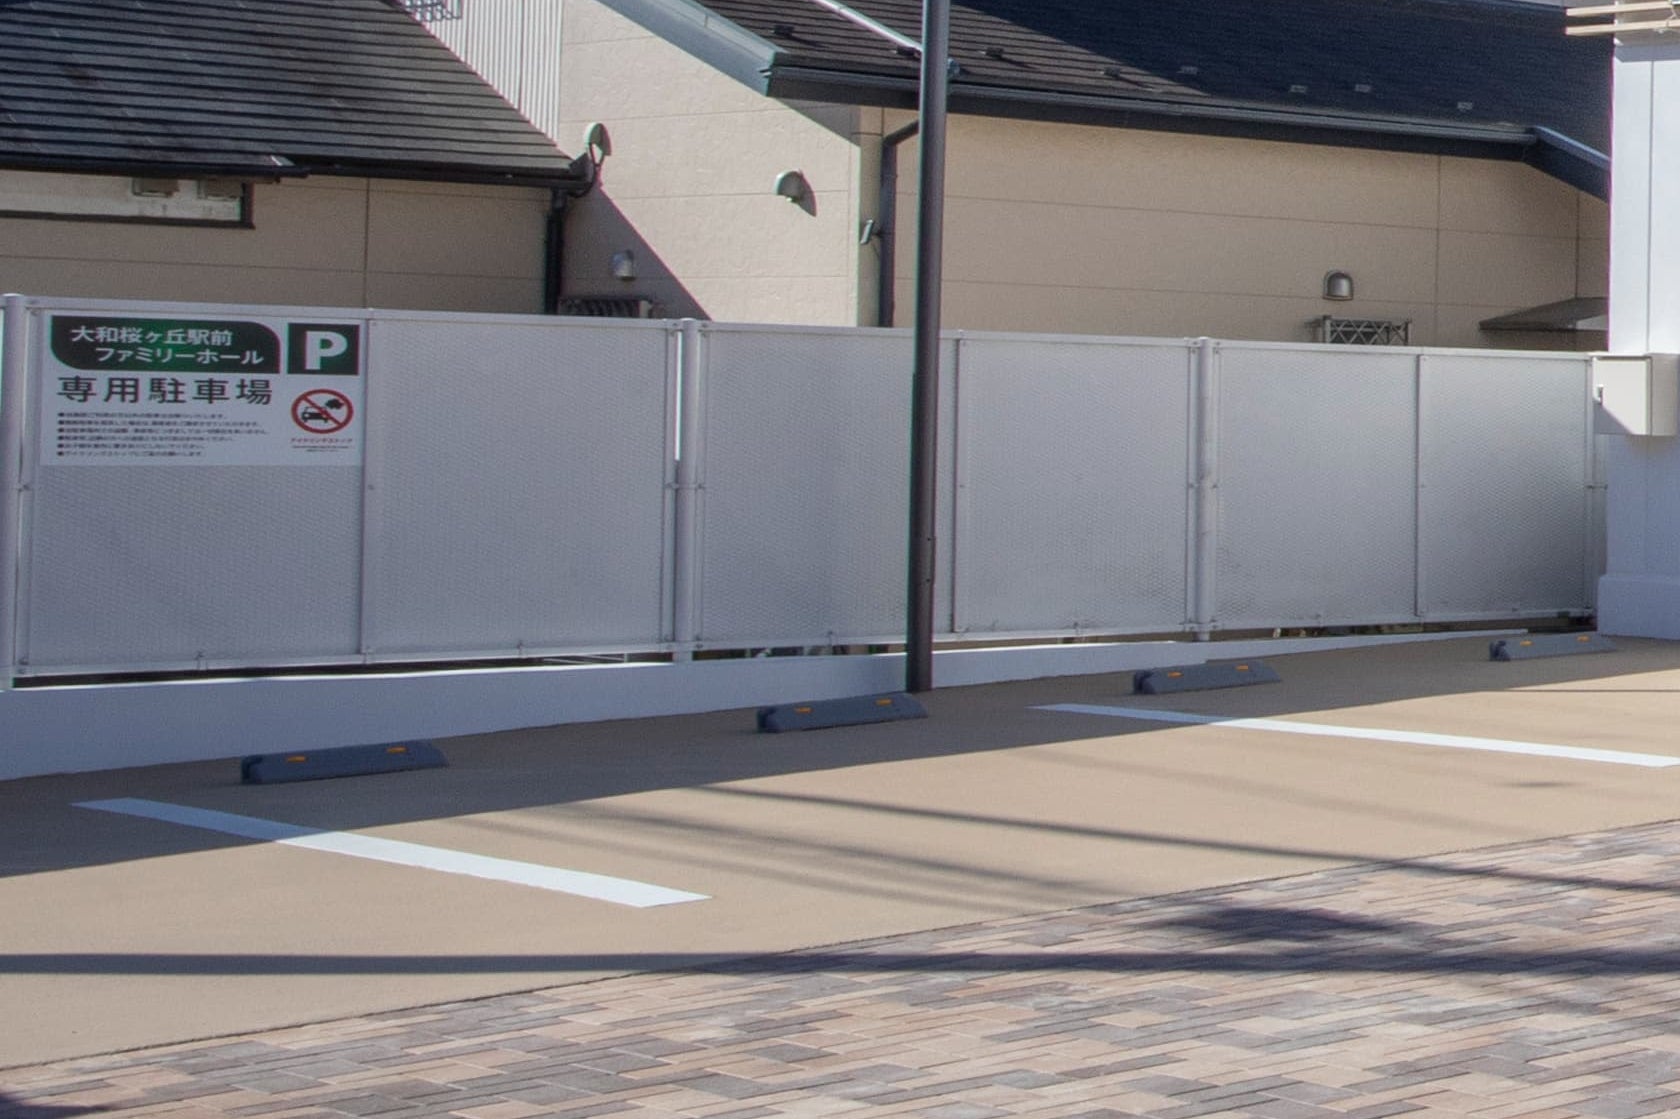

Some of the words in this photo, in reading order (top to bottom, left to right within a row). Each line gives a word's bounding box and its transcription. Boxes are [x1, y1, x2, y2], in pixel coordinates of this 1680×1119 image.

[95, 346, 265, 365] ファミリーホール
[304, 331, 349, 370] P
[57, 375, 273, 406] 専用駐車場
